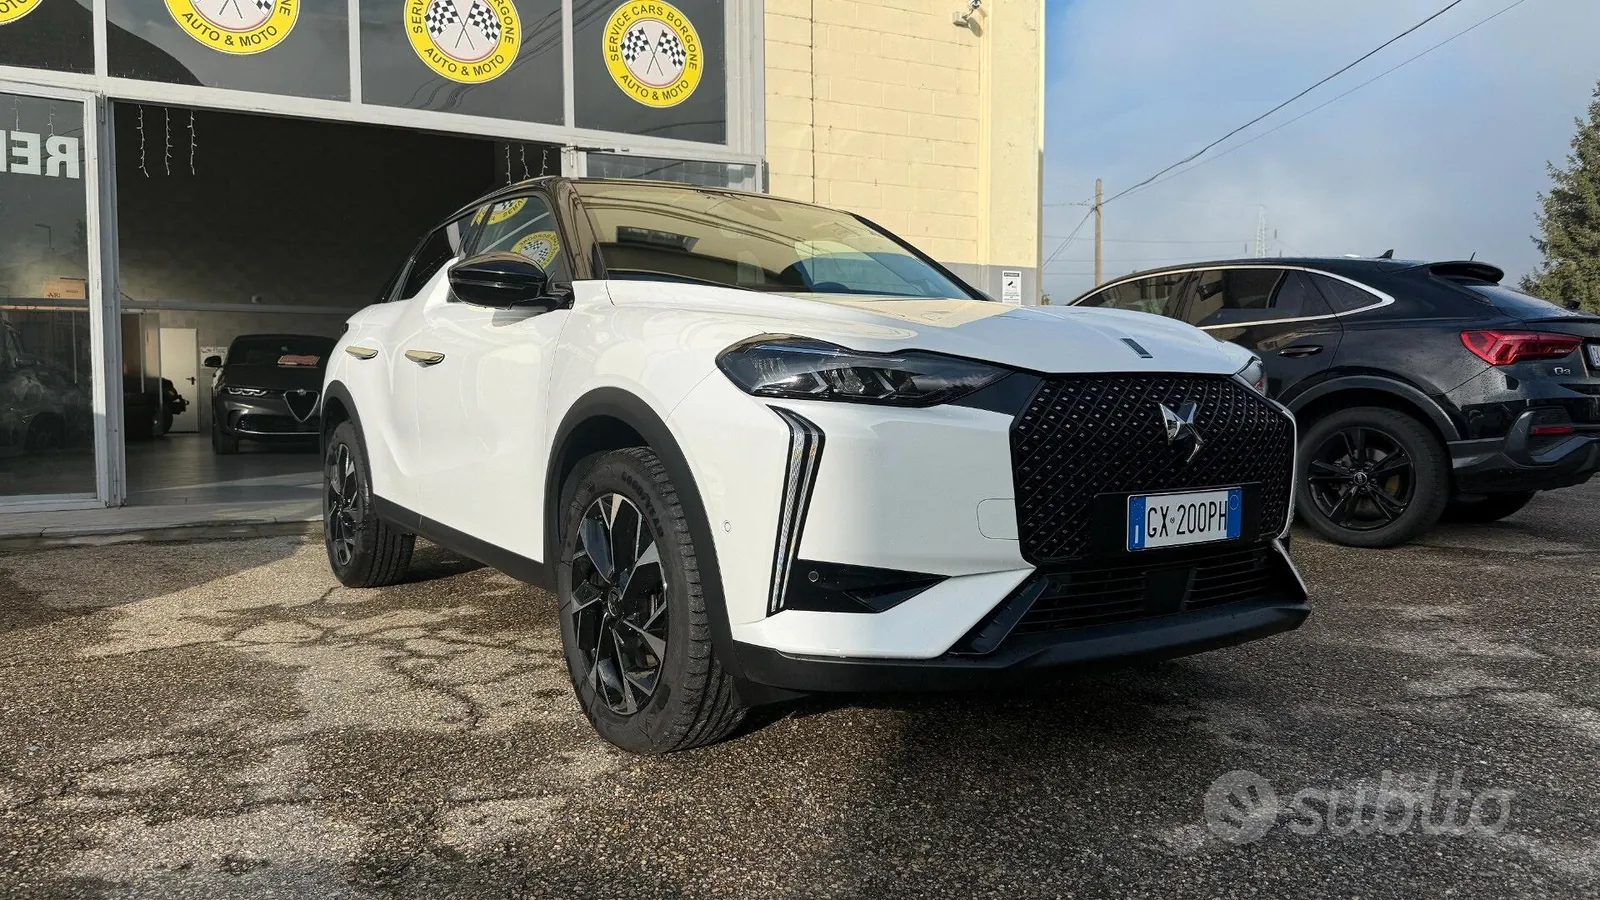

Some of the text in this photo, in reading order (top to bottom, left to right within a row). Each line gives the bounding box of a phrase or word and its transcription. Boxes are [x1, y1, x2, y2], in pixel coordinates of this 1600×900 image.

[181, 12, 278, 47] AUTO & MOTO
[609, 5, 698, 70] SERVICE CARS BORGONE
[424, 48, 505, 76] AUTO & MOTO
[620, 75, 689, 100] AUTO & MOTO
